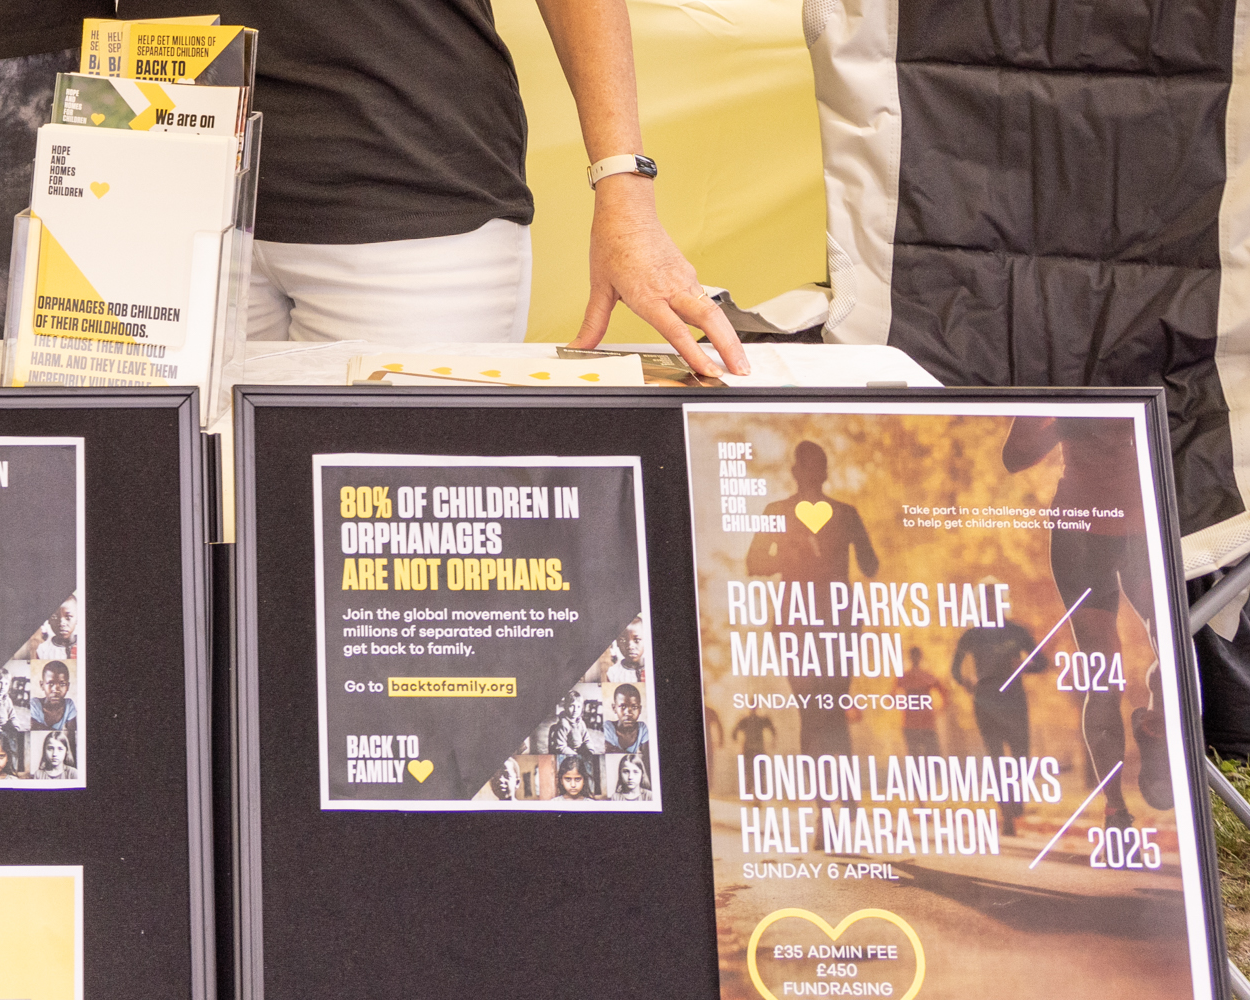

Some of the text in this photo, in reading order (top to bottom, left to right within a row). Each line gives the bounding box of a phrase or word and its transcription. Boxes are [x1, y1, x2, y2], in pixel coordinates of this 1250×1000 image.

[52, 145, 71, 156] HOPE
[51, 156, 65, 165] AND
[50, 166, 76, 176] HOMES
[49, 176, 63, 185] FOR
[48, 186, 83, 197] CHILDREN
[38, 296, 180, 322] ORPHANAGES ROB CHILDREN
[36, 314, 148, 338] OF THEIR CHILDHOODS.
[718, 442, 752, 460] HOPE
[720, 461, 746, 478] AND
[720, 479, 766, 496] HOMES
[722, 497, 746, 514] FOR
[902, 505, 1124, 519] Take part in a challenge and raise funds
[722, 515, 786, 533] CHILDREN
[903, 518, 1091, 532] to help get children back to family
[728, 581, 1010, 628] ROYAL PARKS HALF
[730, 632, 904, 678] MARATHON
[1055, 651, 1126, 692] 2024
[344, 681, 514, 694] Go to backtofamily.org
[733, 694, 932, 710] SUNDAY 13 OCTOBER
[738, 754, 1061, 802] LONDON LANDMARKS
[741, 807, 999, 854] HALF MARATHON
[1087, 827, 1161, 869] 2025
[743, 864, 899, 879] SUNDAY 6 APRIL
[774, 945, 897, 959] £35 ADMIN FEE
[816, 963, 857, 977] £450
[783, 982, 893, 996] FUNDRASING
